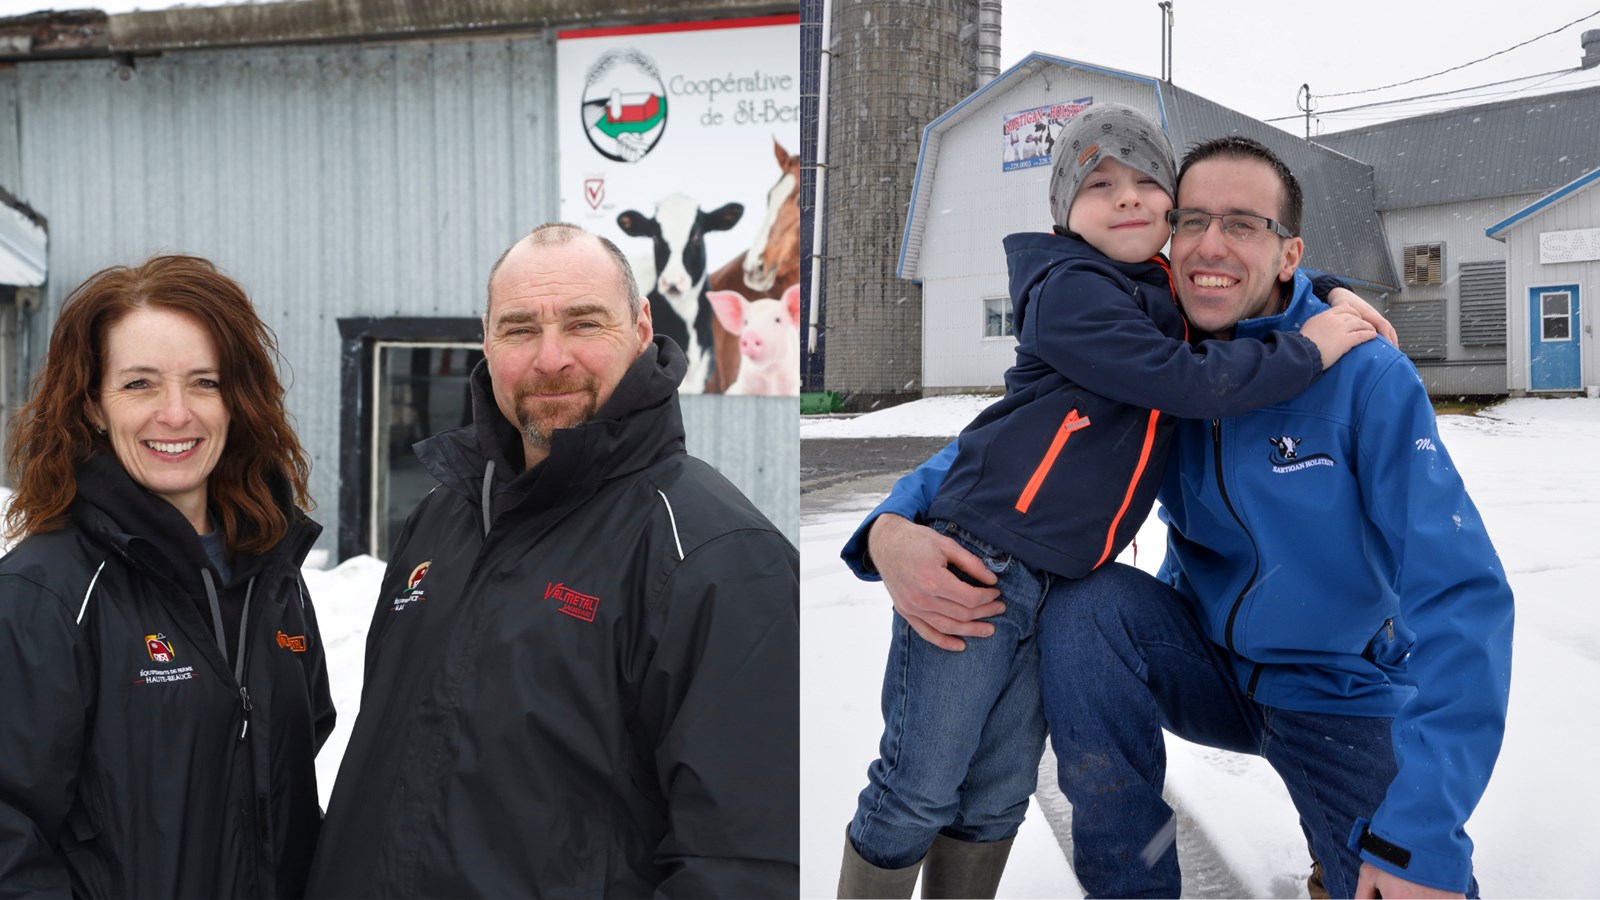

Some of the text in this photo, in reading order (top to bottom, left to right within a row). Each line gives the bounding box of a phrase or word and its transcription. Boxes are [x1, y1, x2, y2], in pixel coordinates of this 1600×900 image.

[669, 70, 793, 102] Coopérative
[700, 106, 723, 126] de
[1272, 458, 1334, 473] SARTIGAN HOLSTEIN
[544, 582, 593, 610] VALMETAL
[146, 672, 193, 683] HAUTE-BEAUCE
